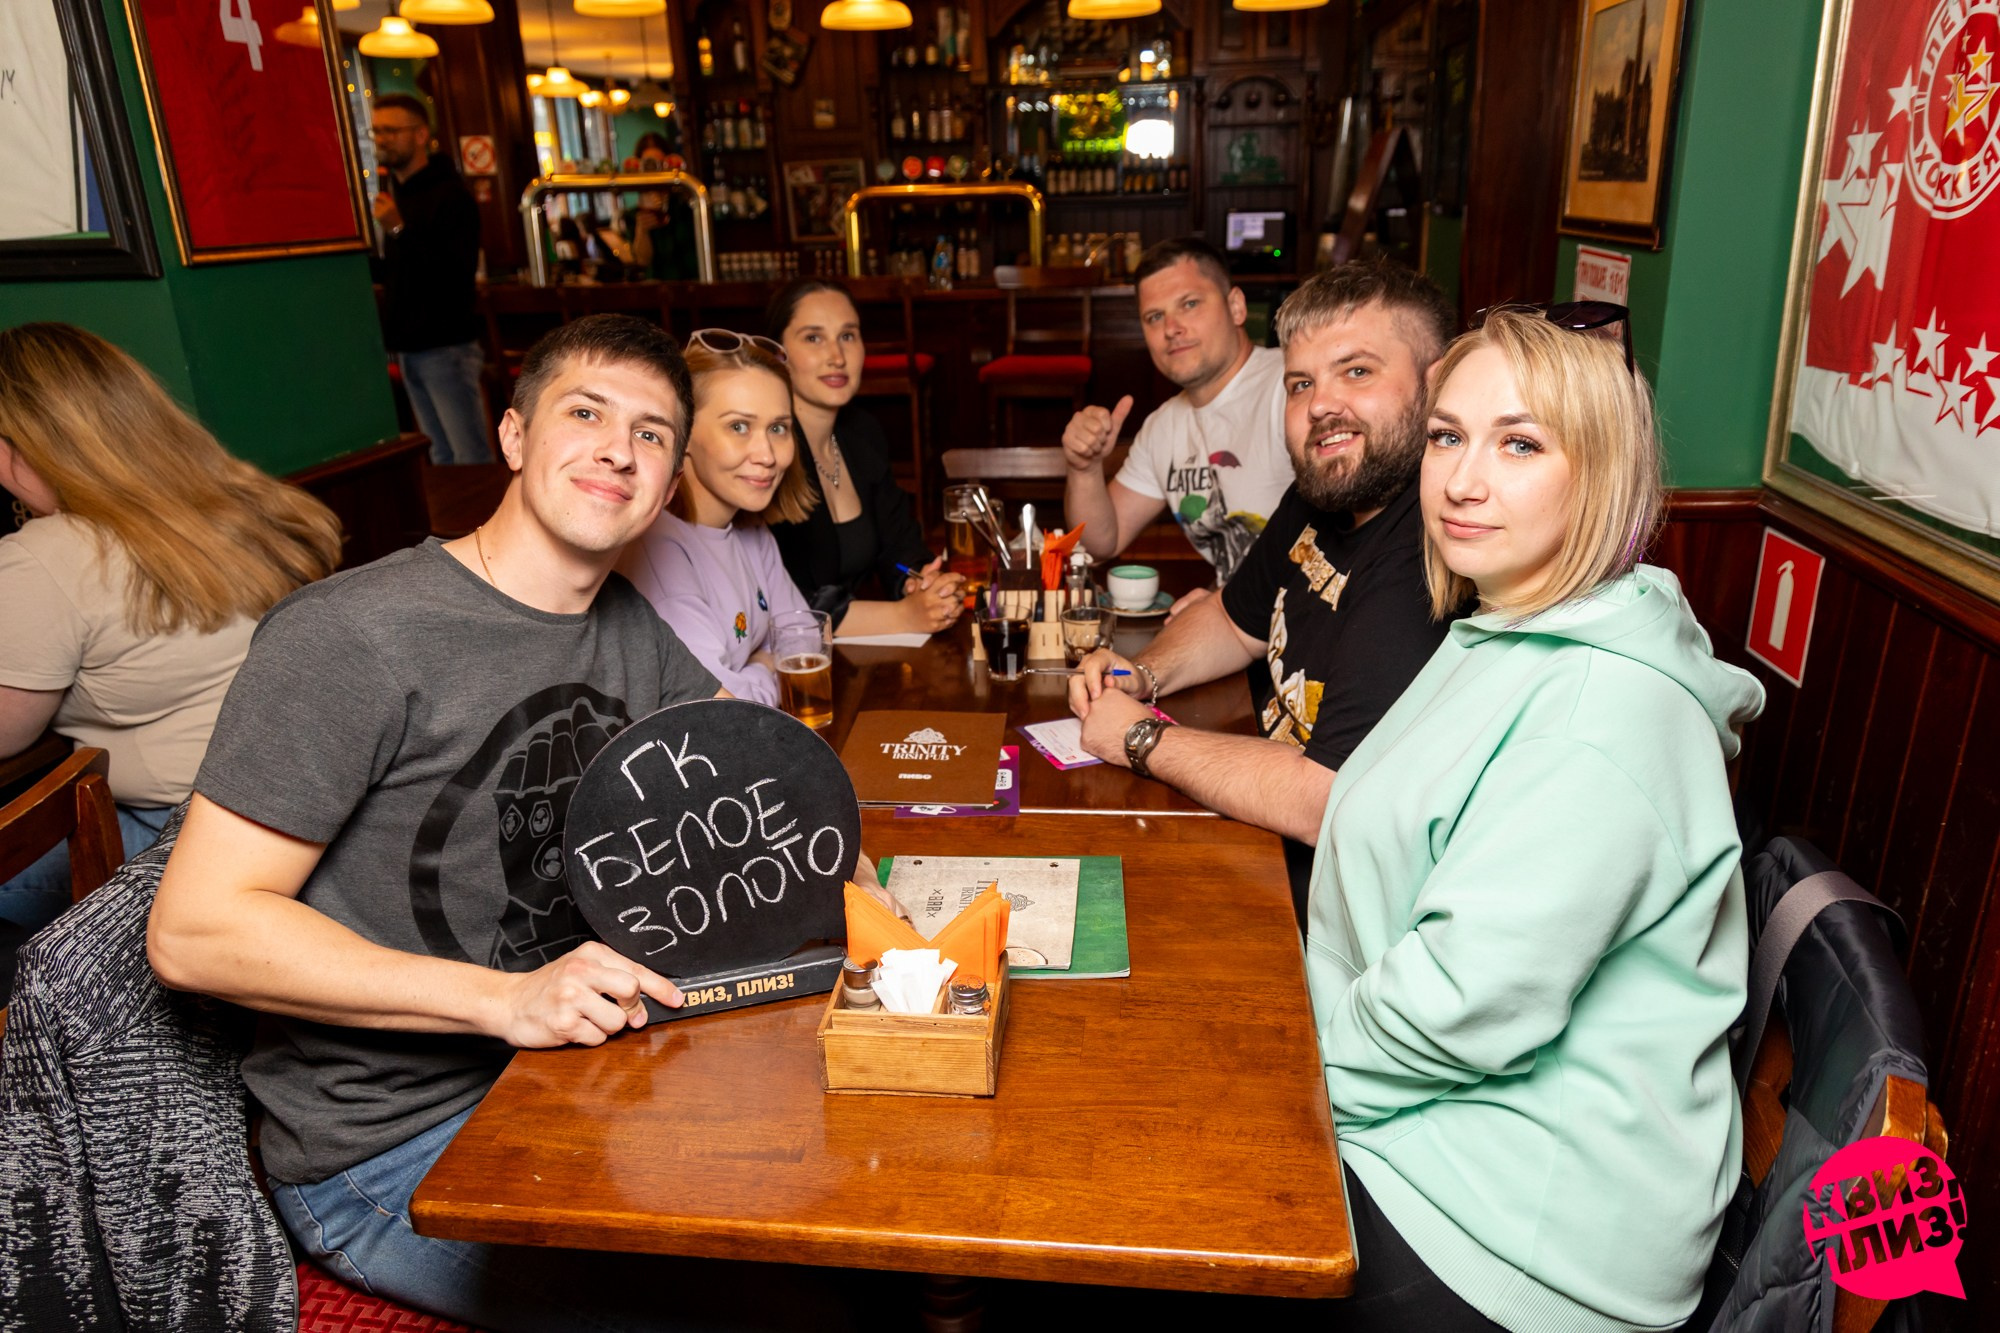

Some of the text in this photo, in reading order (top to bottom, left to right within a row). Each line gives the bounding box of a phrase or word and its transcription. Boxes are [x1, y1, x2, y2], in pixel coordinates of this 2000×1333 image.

[1913, 140, 1999, 200] ХОККЕЯ
[620, 732, 718, 800] ГК
[880, 743, 967, 756] TRINITY
[574, 778, 798, 890] БЕЛОЕ
[617, 825, 845, 956] ЗОЛОТО
[736, 973, 794, 997] ПЛИЗ!
